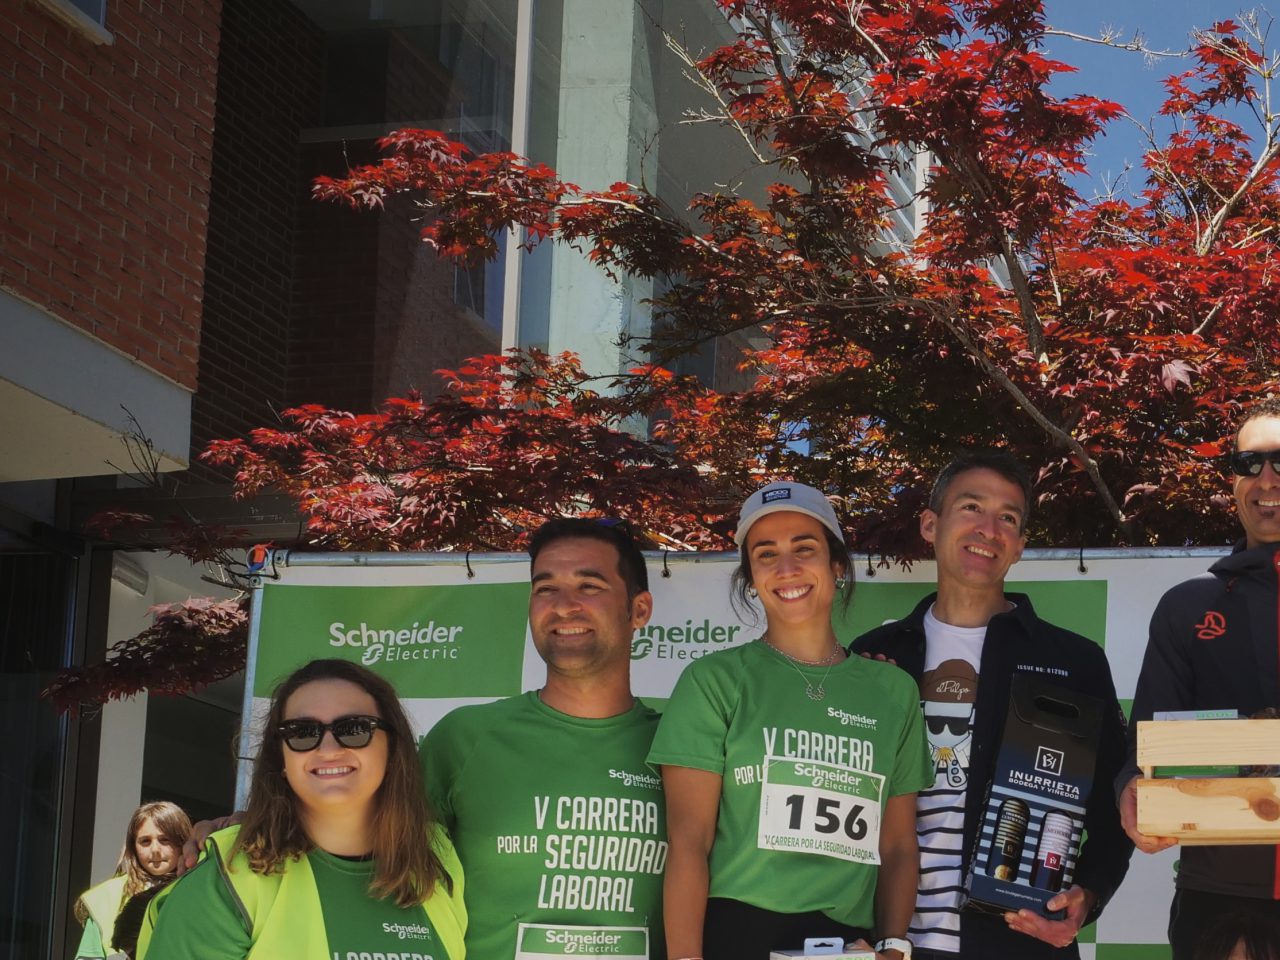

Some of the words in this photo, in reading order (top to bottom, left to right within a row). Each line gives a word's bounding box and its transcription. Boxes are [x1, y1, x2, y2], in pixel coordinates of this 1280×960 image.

[329, 620, 464, 647] Schneider
[638, 619, 741, 644] neider
[385, 645, 459, 662] Electric
[827, 706, 878, 726] Schneider
[762, 727, 778, 756] V
[784, 728, 874, 773] CARRERA
[608, 769, 662, 786] Schneider
[734, 764, 755, 786] POR
[794, 762, 862, 787] Schneider
[825, 779, 861, 795] Electric
[1009, 769, 1081, 796] INURRIETA
[534, 795, 550, 830] V
[556, 795, 658, 835] CARRERA
[785, 793, 869, 841] 156
[497, 835, 521, 854] POR
[523, 835, 538, 854] LA
[544, 834, 669, 875] SEGURIDAD
[537, 873, 635, 913] LABORAL
[545, 929, 622, 946] Schneider
[578, 944, 620, 954] Electric
